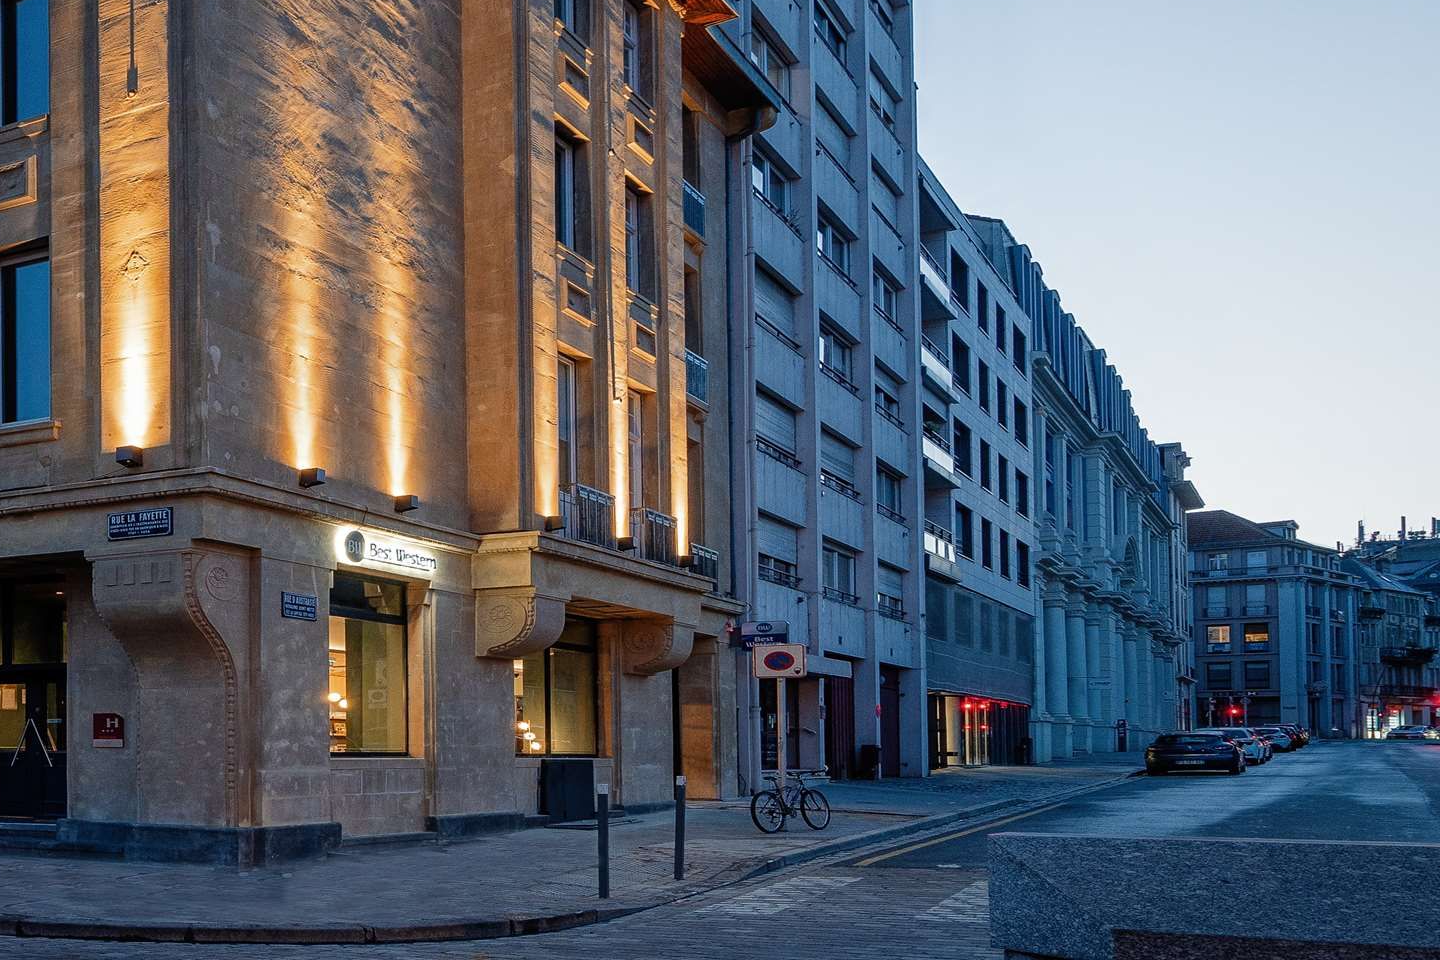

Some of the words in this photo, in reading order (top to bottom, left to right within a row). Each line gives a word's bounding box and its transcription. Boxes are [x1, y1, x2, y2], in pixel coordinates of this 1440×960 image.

[111, 515, 126, 525] RUE
[127, 514, 136, 523] LA
[139, 510, 168, 521] FAYETTE
[370, 543, 392, 560] Best
[395, 548, 437, 570] Western
[106, 718, 119, 728] H
